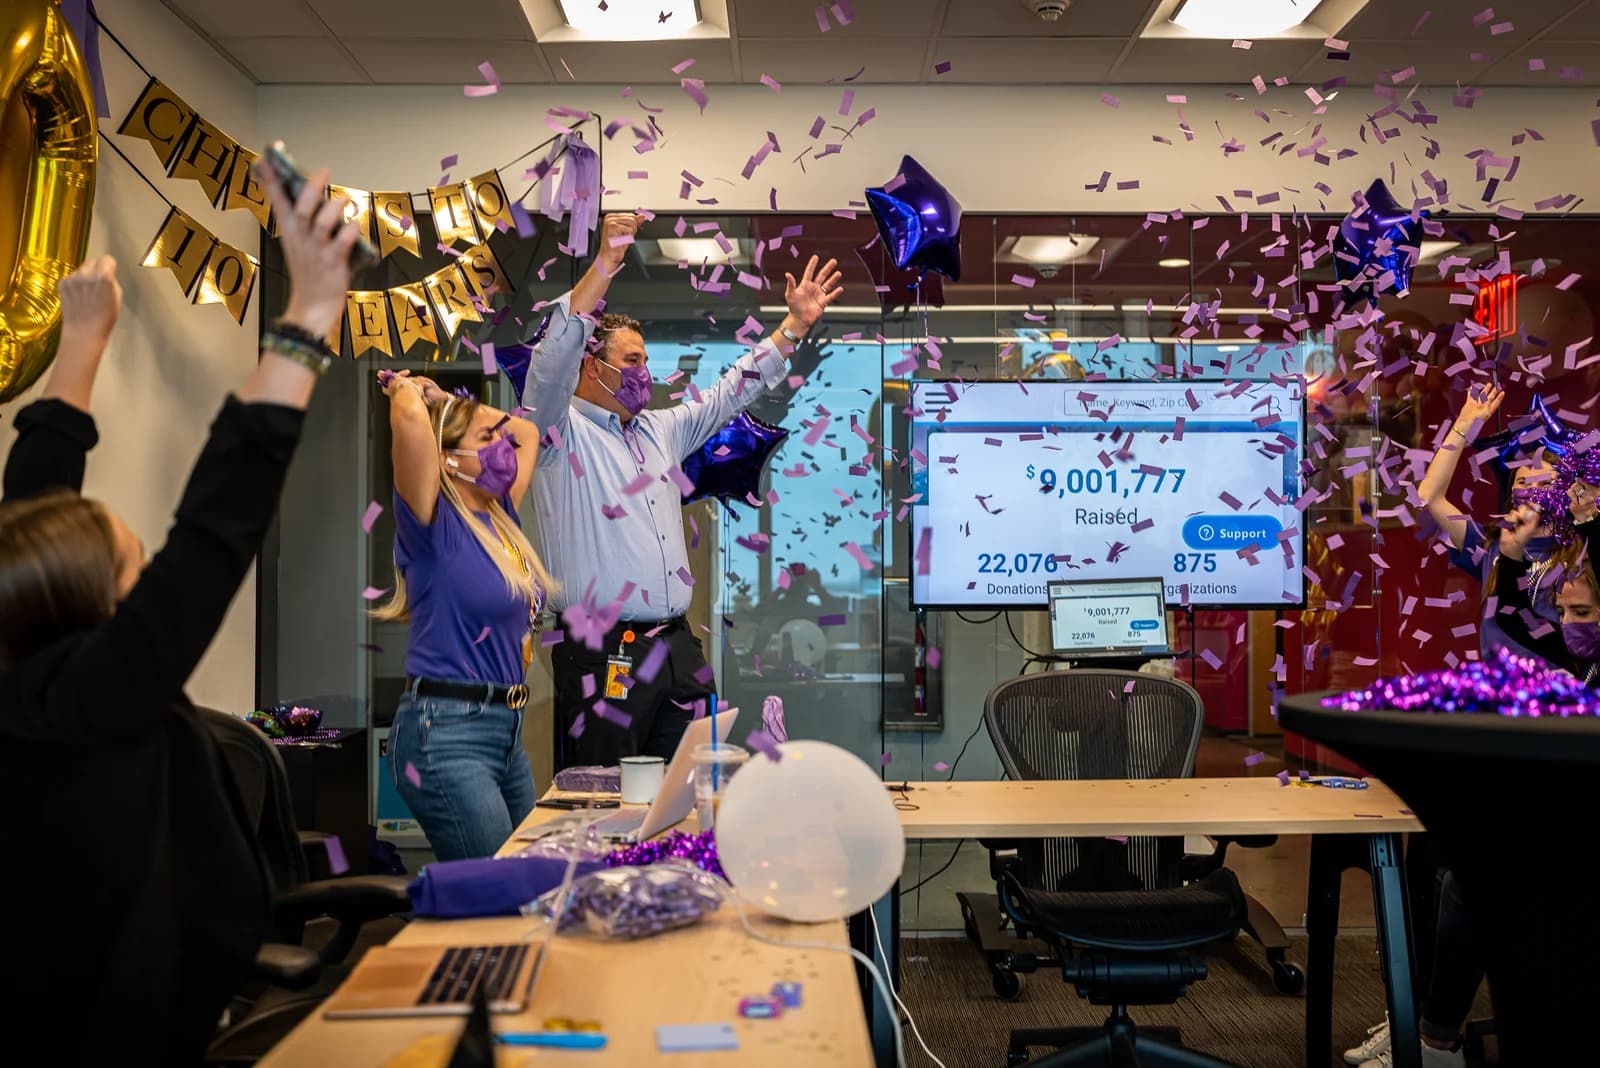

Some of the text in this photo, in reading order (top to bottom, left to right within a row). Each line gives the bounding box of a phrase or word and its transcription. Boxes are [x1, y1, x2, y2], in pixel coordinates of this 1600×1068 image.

[434, 182, 504, 228] TO
[167, 226, 496, 337] 10 EARS
[1160, 397, 1176, 409] Zip
[1075, 507, 1138, 525] Raised
[1220, 528, 1267, 541] Support
[978, 553, 1058, 577] 22,076
[1173, 553, 1217, 573] 875
[987, 583, 1048, 595] Donations
